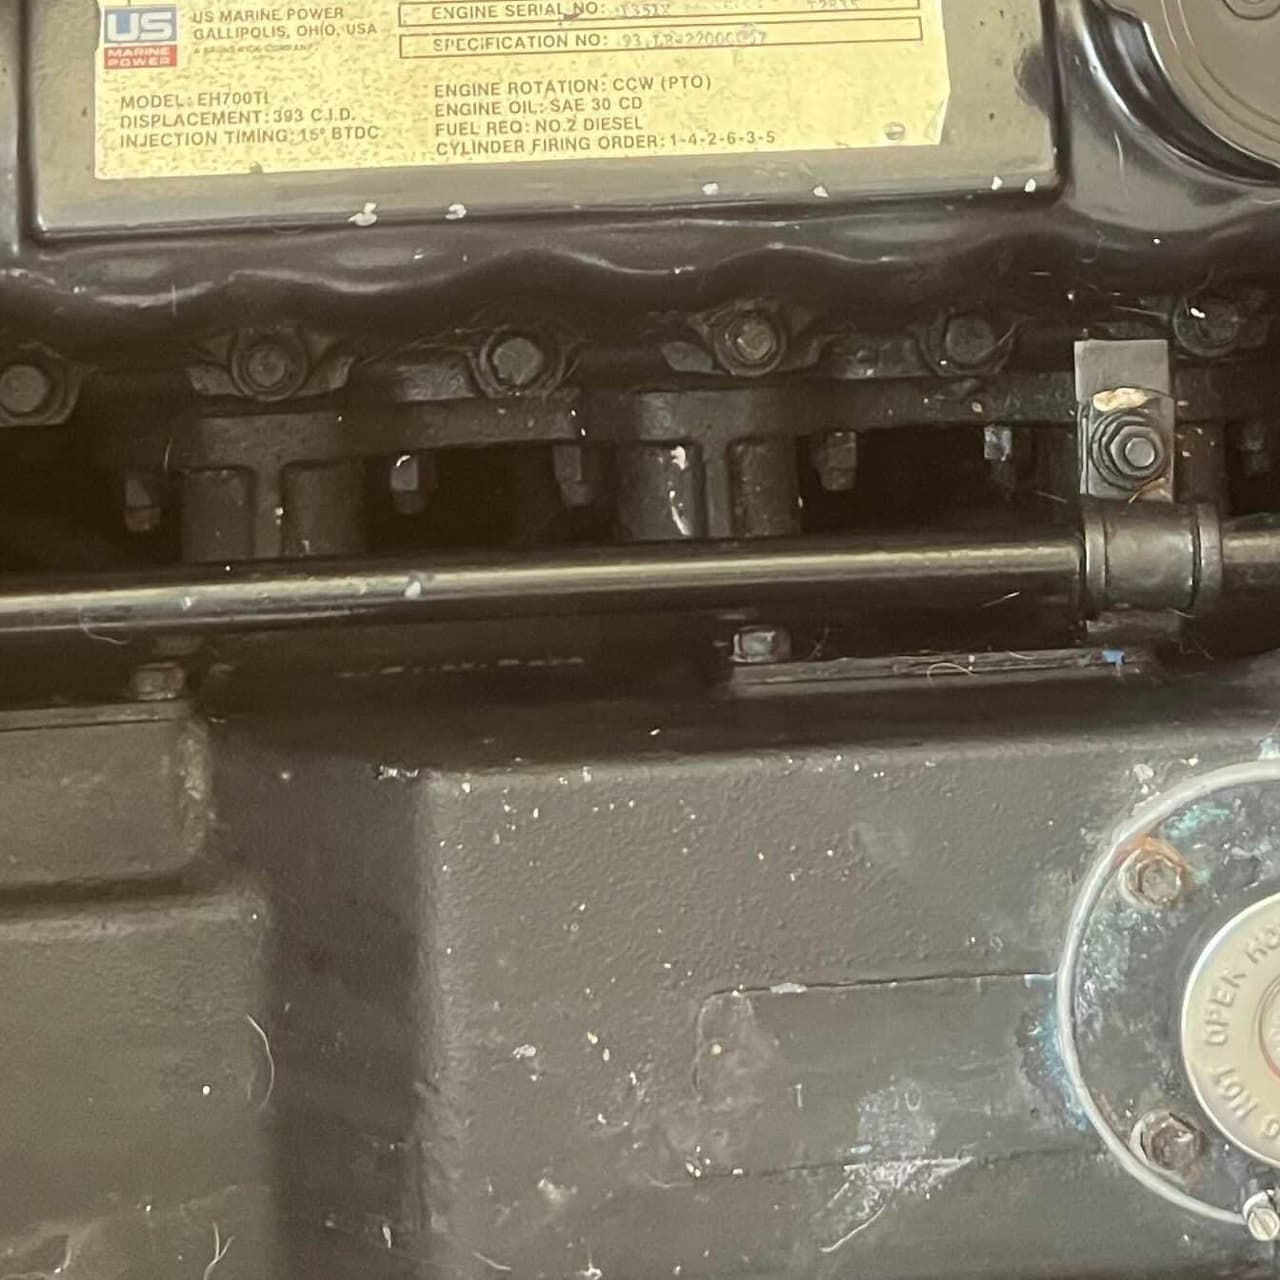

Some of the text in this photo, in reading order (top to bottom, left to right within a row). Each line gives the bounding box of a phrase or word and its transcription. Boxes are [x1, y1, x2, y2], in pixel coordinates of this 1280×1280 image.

[192, 6, 344, 23] US MARINE POWER
[431, 5, 498, 20] ENGINE
[505, 2, 563, 18] SERIAL
[572, 1, 606, 15] NO:
[108, 11, 173, 42] US
[193, 23, 377, 40] GALLIPOLIS, OHIO, USA
[107, 46, 169, 57] MARINE
[432, 34, 569, 52] SPECIFICATION
[575, 32, 609, 46] NO:
[107, 56, 170, 67] POWER
[434, 75, 712, 98] ENGINE ROTATION: CCW (PTO)
[120, 94, 192, 110] MODEL:
[434, 96, 643, 118] ENGINE OIL: SAE 30 CD
[120, 107, 356, 129] DISPLACEMENT: 393 C.I.D.
[435, 121, 479, 138] FUEL
[583, 116, 643, 131] DIESEL
[120, 131, 217, 149] INJECTION
[223, 128, 294, 144] TIMING:
[331, 125, 380, 140] BTDC
[436, 131, 776, 157] CYLINDER FIRING ORDER: 1-4-2-6-3-5
[1206, 968, 1248, 1048] OPEN
[1216, 1065, 1259, 1121] NOT
